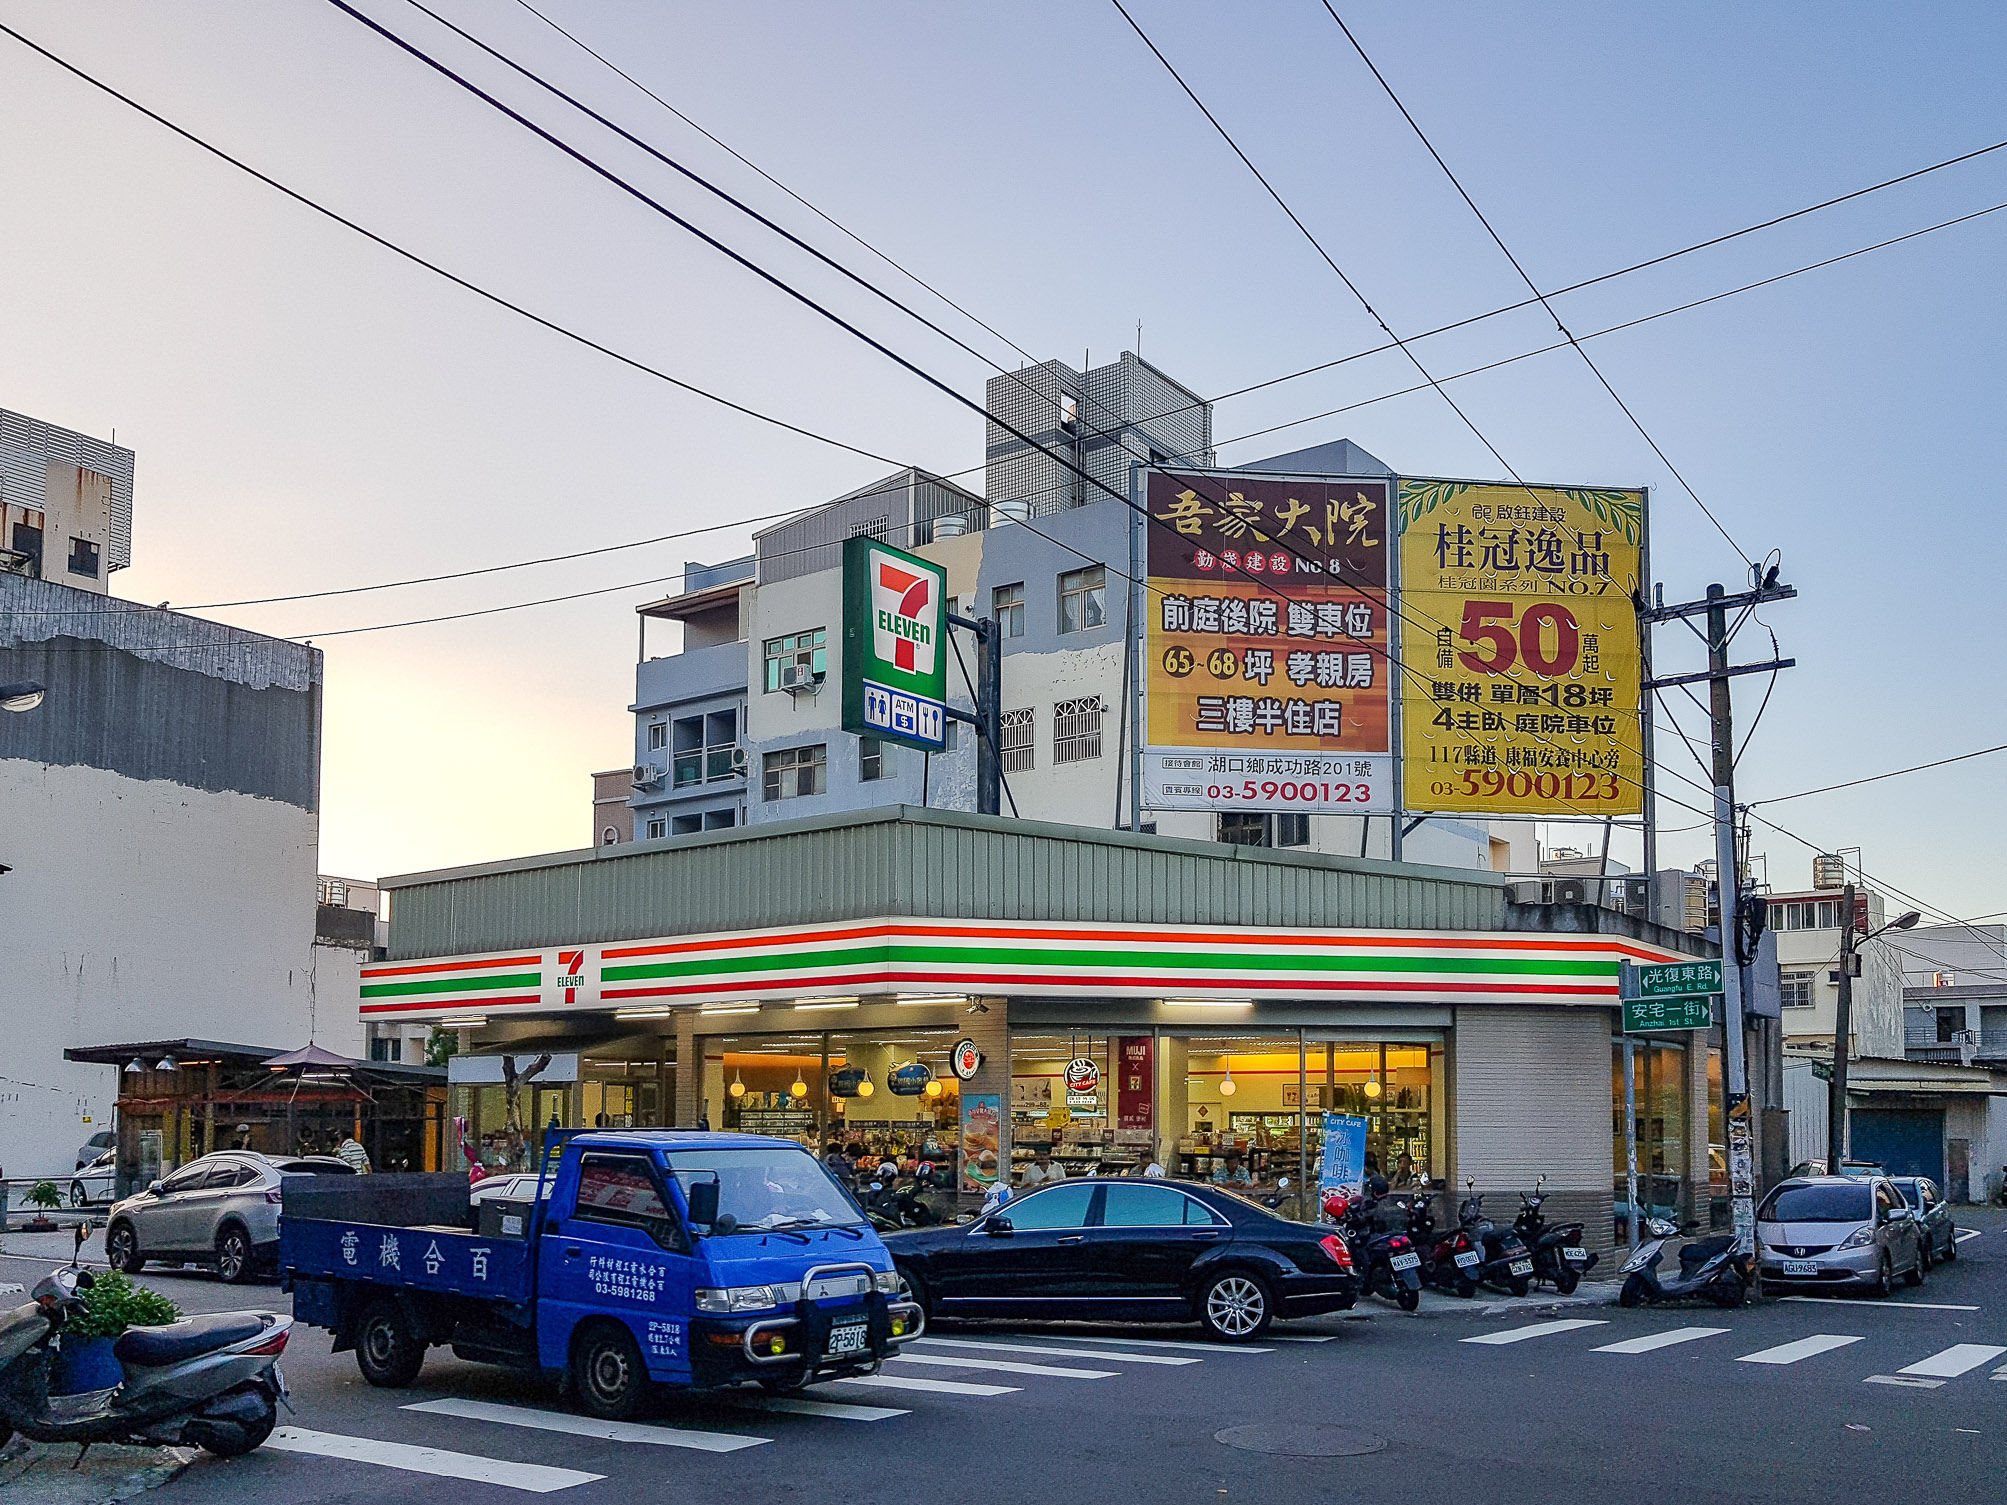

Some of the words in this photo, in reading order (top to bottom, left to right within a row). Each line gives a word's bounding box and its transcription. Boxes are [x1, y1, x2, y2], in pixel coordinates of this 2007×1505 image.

[1433, 522, 1610, 577] 桂冠逸品
[880, 563, 928, 672] 7
[1163, 598, 1277, 634] 前庭後院
[1288, 602, 1373, 637] 雙車位
[1457, 600, 1579, 677] 50
[1582, 633, 1600, 674] 萬起
[1288, 651, 1374, 688] 孝親房
[1432, 681, 1482, 702] 雙併
[895, 699, 914, 713] ATM
[1198, 698, 1340, 735] 三樓半住店
[1432, 707, 1506, 732] 4主臥
[1514, 712, 1616, 735] 庭院車位
[1207, 756, 1373, 778] 湖口鄉成功路201號
[1430, 745, 1497, 765] 117縣道
[1505, 746, 1620, 769] 康福安養中心旁
[1207, 780, 1371, 803] 03-5900123
[1430, 769, 1620, 800] 03-5900123
[558, 950, 584, 1004] 7
[1648, 965, 1713, 984] 光復東路
[1631, 1001, 1700, 1019] 安宅一街
[1126, 1045, 1146, 1056] MUJI
[595, 1282, 655, 1302] 03-5981268
